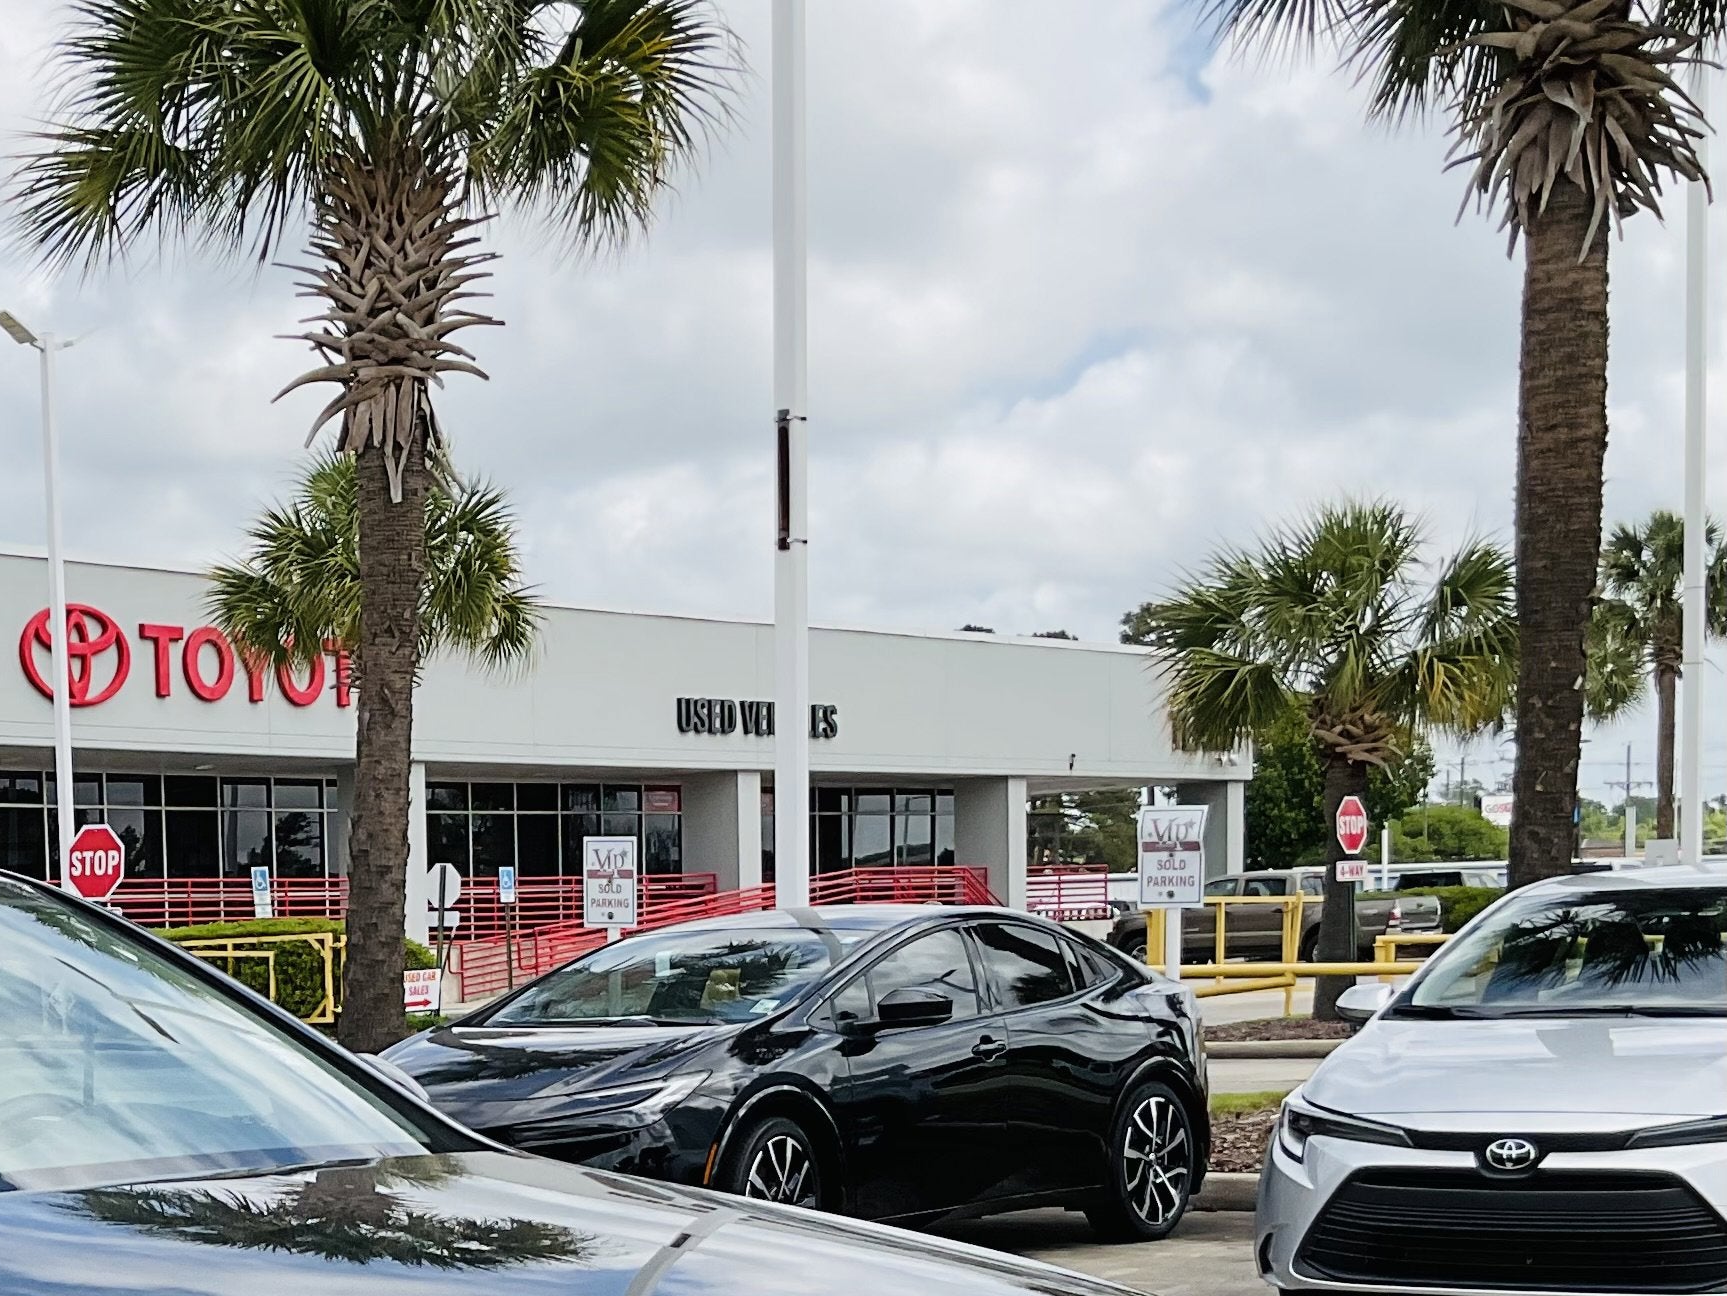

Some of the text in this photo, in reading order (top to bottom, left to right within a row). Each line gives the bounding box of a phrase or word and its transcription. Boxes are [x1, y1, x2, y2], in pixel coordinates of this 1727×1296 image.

[676, 697, 737, 735] USED
[1339, 815, 1364, 835] STOP
[70, 849, 120, 877] STOP
[1157, 859, 1186, 870] SOLD
[1340, 864, 1364, 878] 4-WAY
[1146, 875, 1195, 887] PARKING
[598, 883, 623, 895] SOLD
[590, 898, 630, 909] PARKING
[408, 985, 429, 996] SALES
